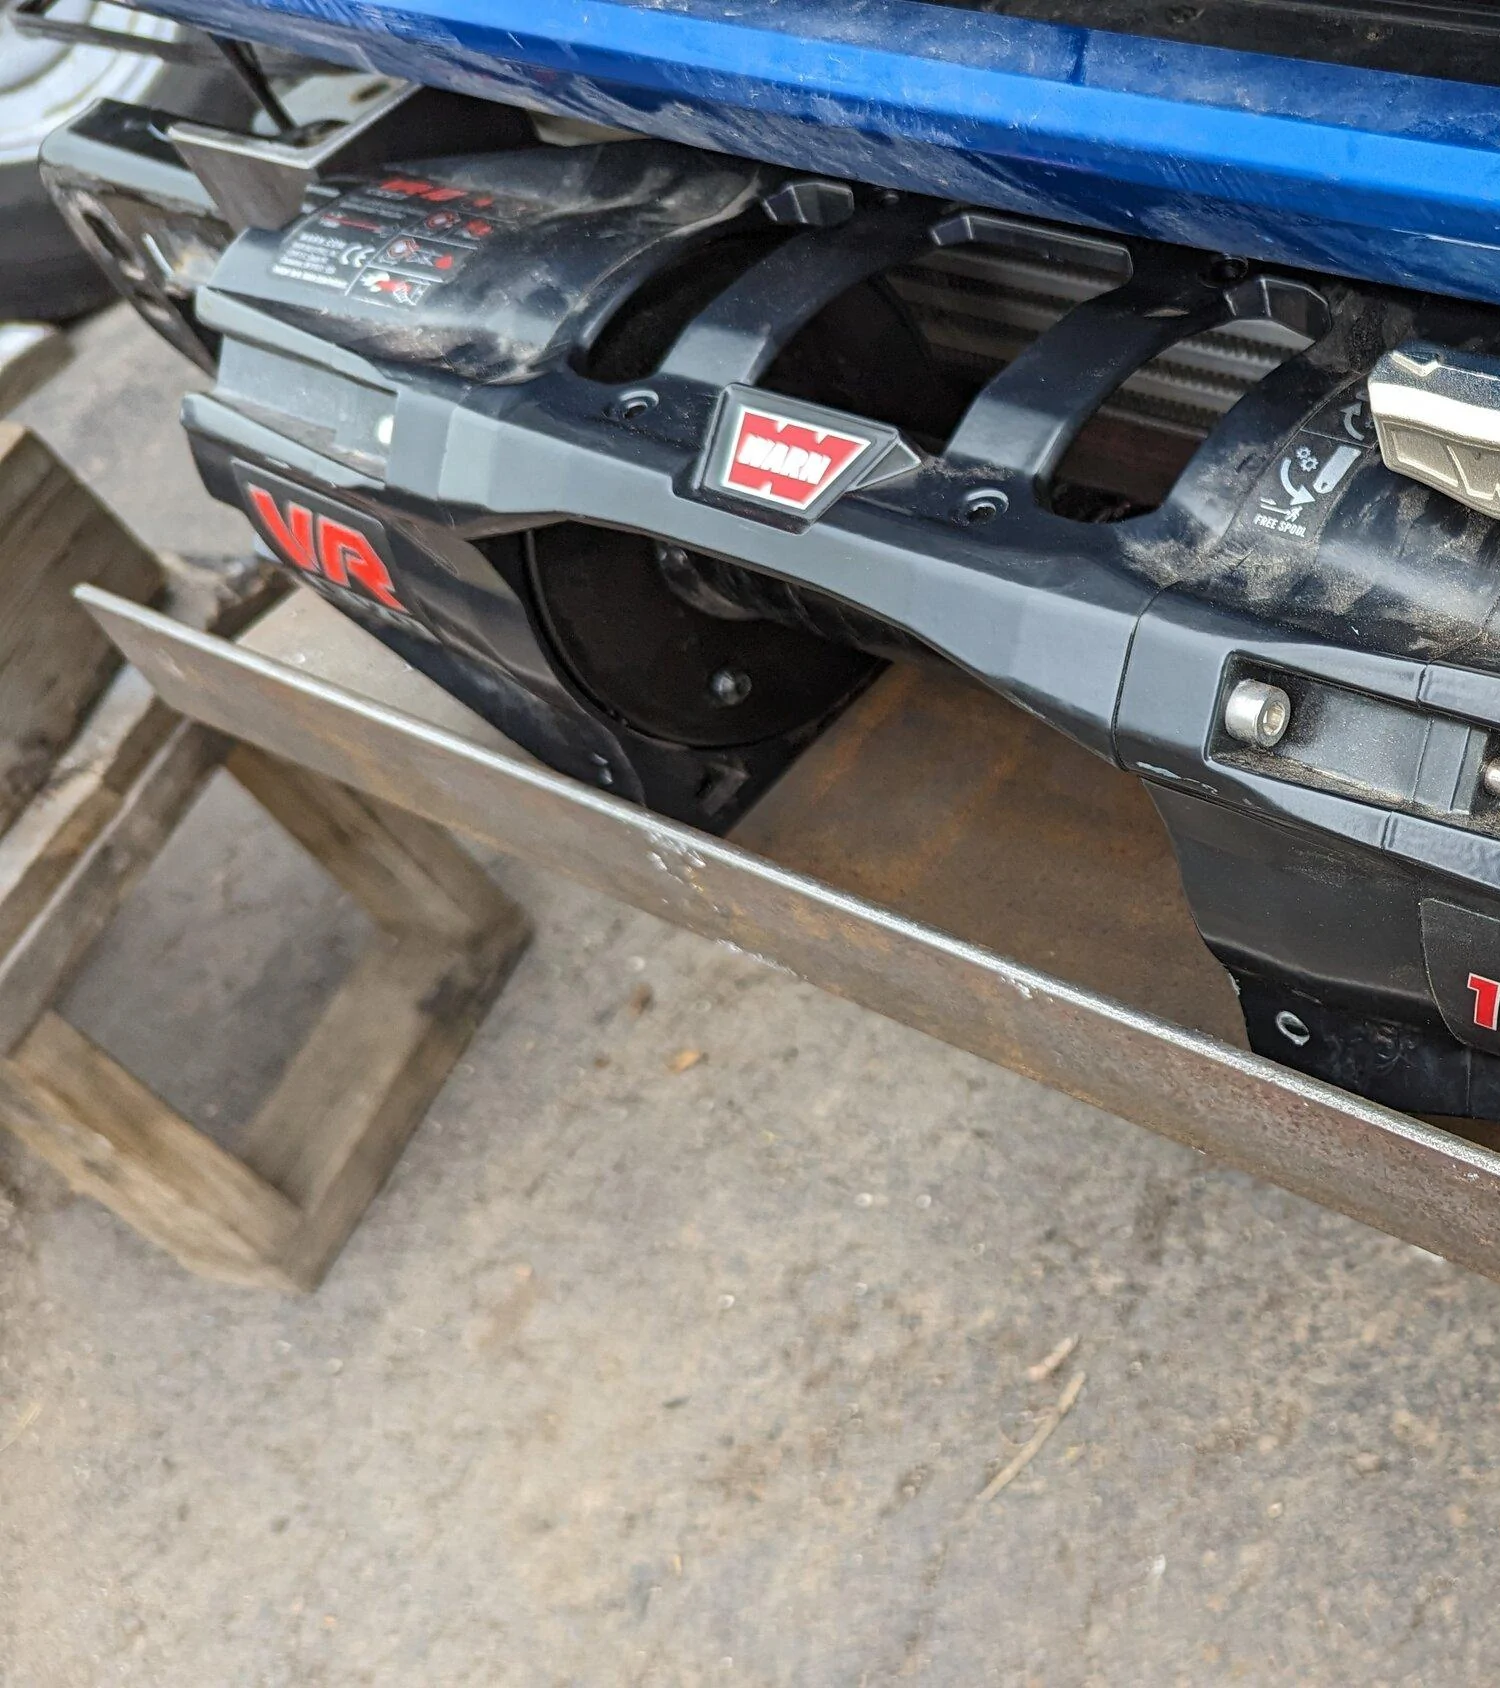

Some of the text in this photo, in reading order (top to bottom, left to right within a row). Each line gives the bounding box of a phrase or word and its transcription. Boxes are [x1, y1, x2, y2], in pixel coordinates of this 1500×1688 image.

[736, 432, 832, 485] WARN
[248, 482, 411, 616] VR
[1253, 513, 1306, 538] FREE SPOOL
